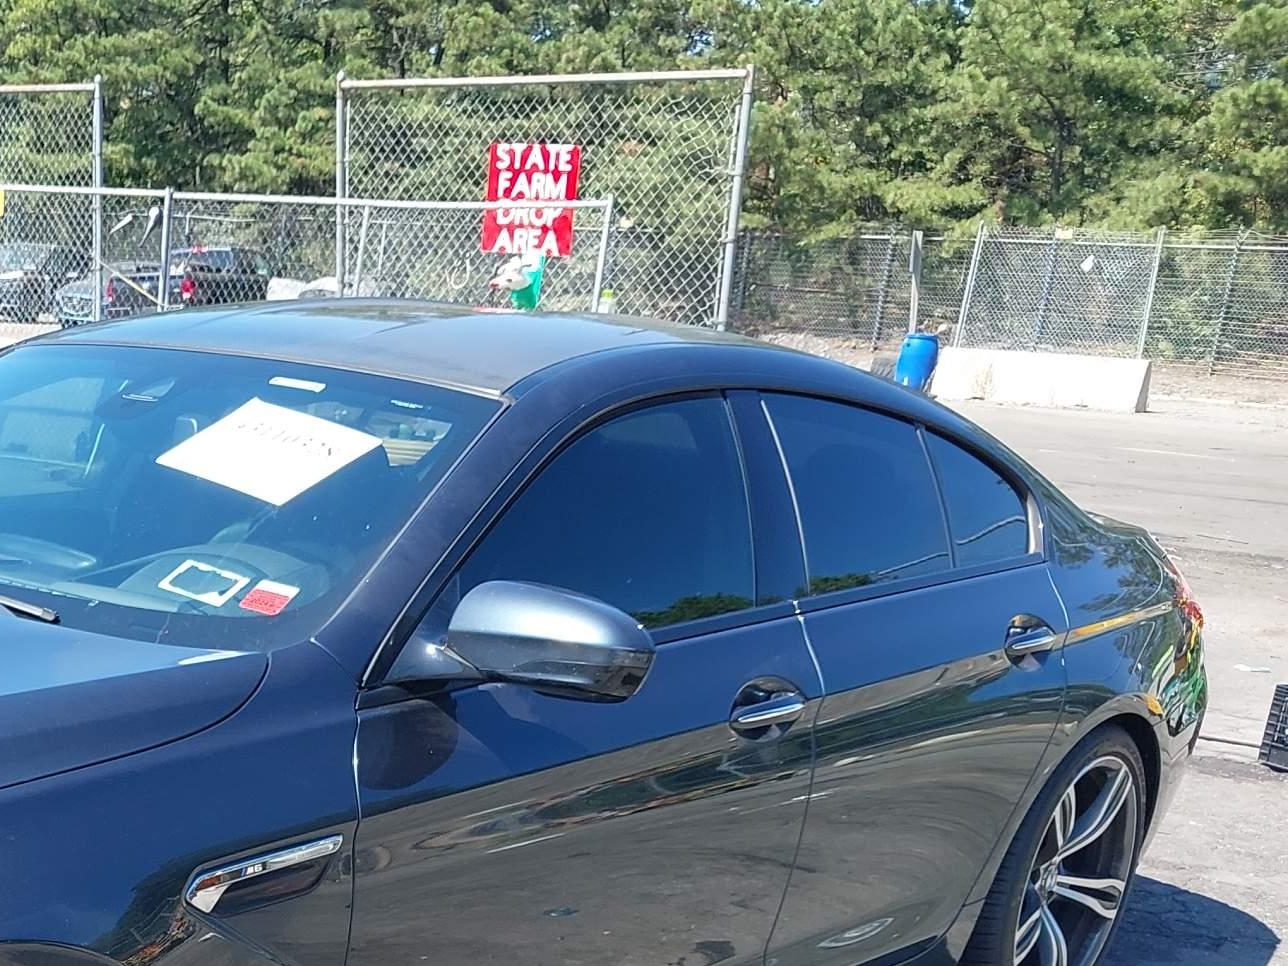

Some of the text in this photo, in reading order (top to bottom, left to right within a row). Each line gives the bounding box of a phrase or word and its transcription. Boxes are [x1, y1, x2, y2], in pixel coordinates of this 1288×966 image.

[496, 143, 573, 172] STATE
[498, 171, 568, 200] FARM
[492, 227, 561, 257] AREA
